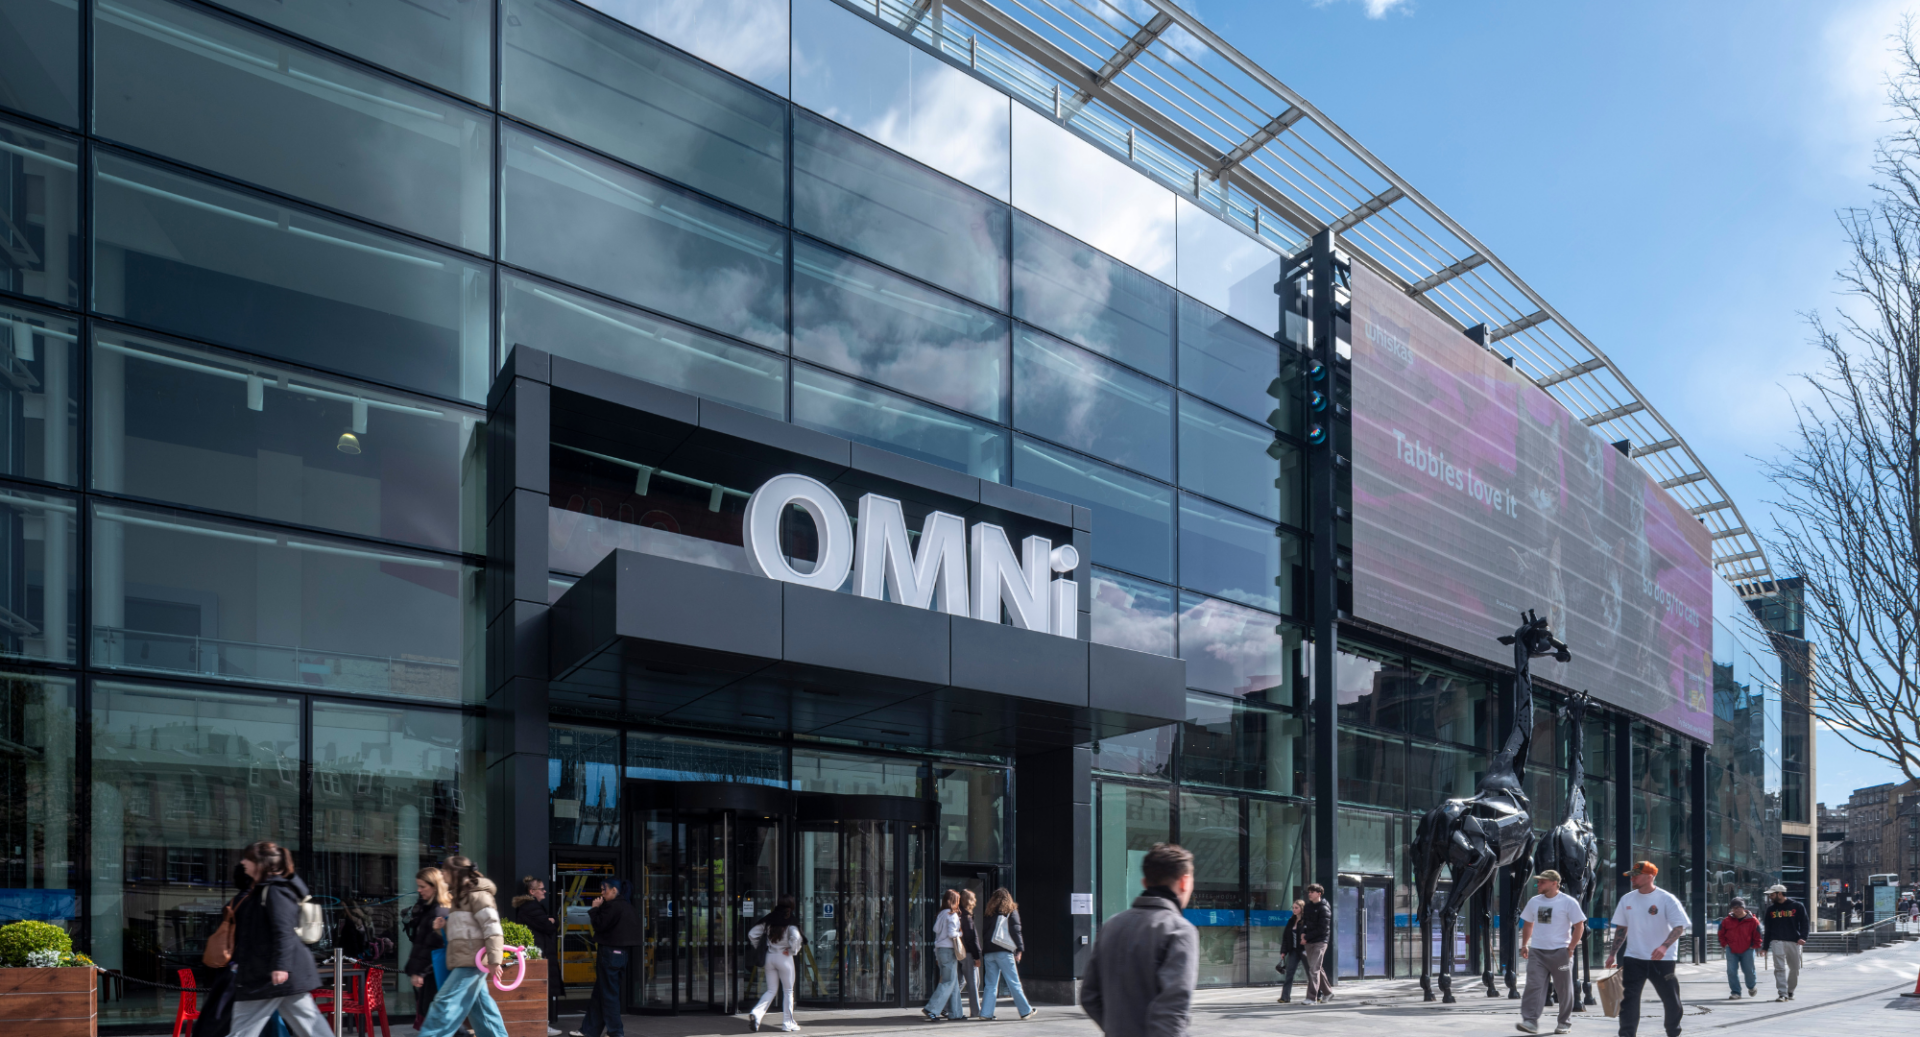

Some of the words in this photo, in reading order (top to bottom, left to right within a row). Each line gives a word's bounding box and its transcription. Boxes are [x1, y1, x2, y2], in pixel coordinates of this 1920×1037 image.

[1392, 428, 1464, 491] Tabbies
[1468, 467, 1502, 511] love
[1506, 488, 1518, 519] it
[742, 472, 1079, 640] OMNi
[1643, 577, 1653, 597] so
[1654, 580, 1665, 605] do
[1685, 606, 1700, 629] cats
